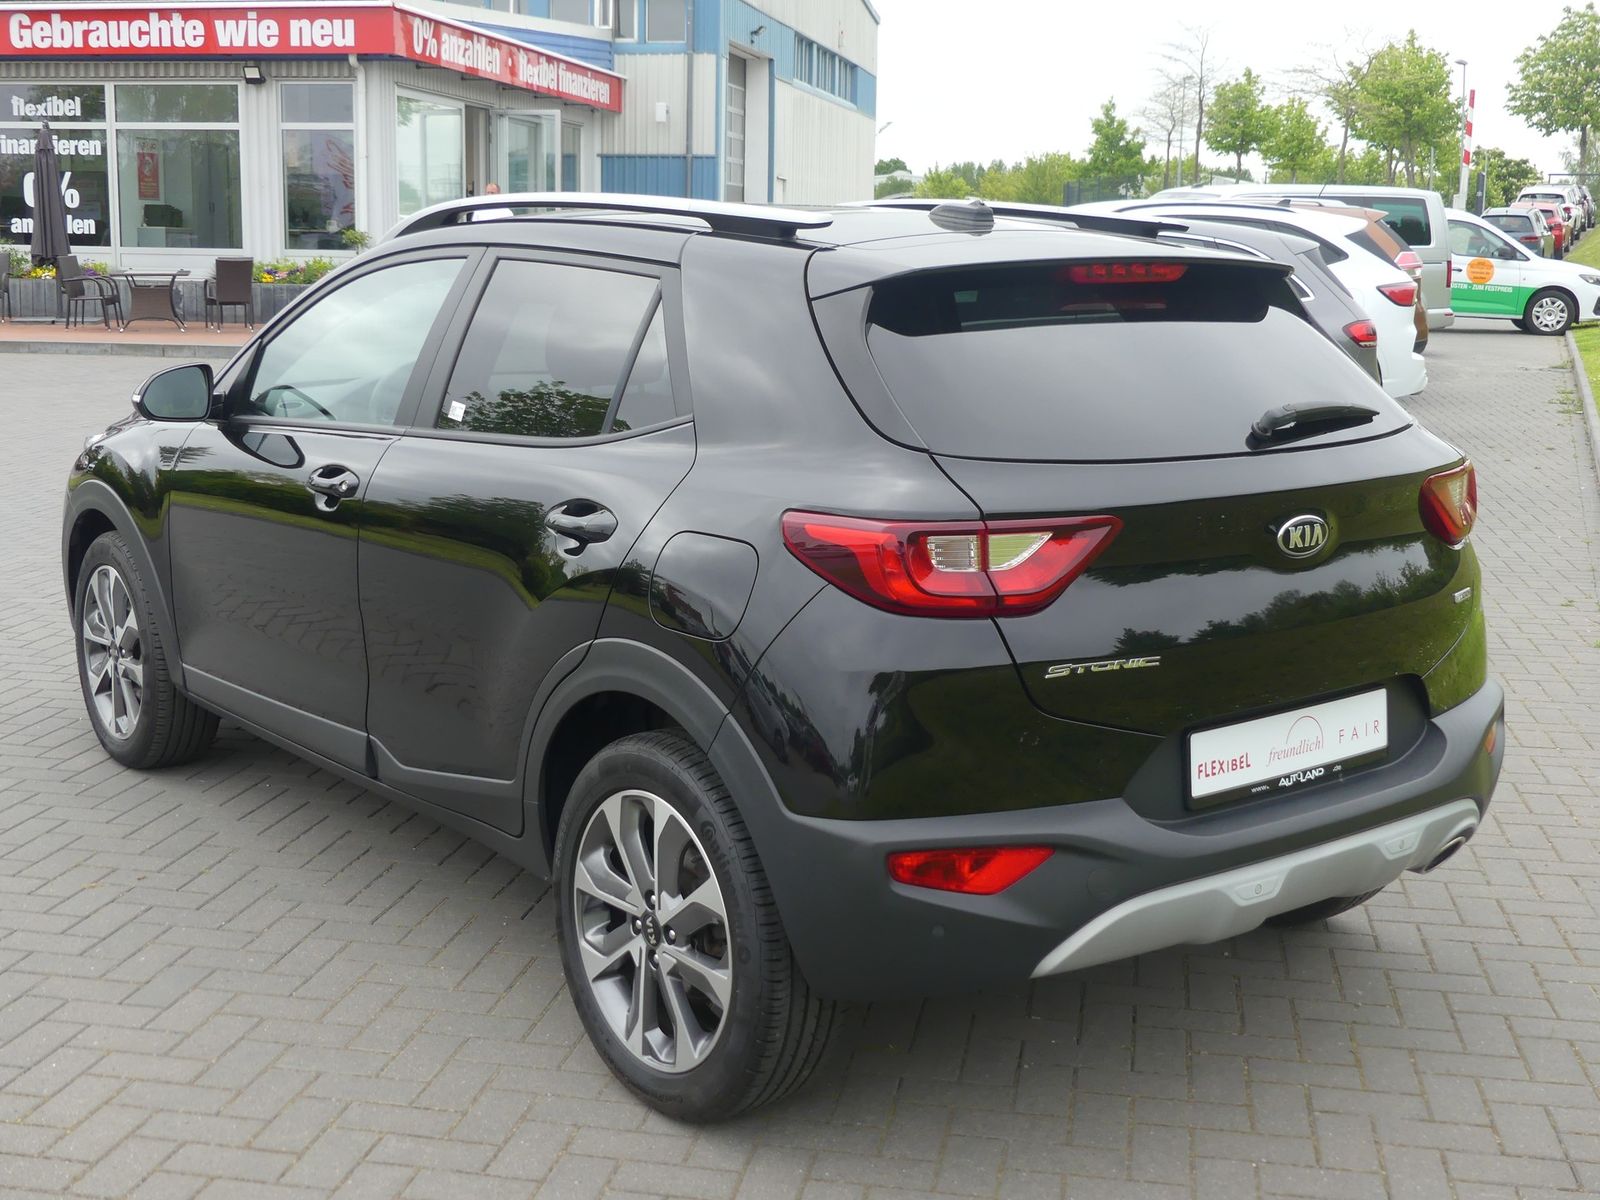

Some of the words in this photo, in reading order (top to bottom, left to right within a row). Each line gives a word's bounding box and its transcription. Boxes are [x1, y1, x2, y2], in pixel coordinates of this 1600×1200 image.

[9, 12, 205, 49] Gebrauchte
[214, 12, 279, 48] wie
[289, 18, 355, 47] neu
[413, 17, 437, 58] 0%
[441, 31, 500, 75] anzahlen
[519, 49, 558, 90] flexibel
[559, 61, 610, 104] finanzieren
[11, 95, 82, 117] flexibel
[0, 135, 102, 155] inanieren
[11, 214, 96, 235] anlen
[1289, 523, 1323, 549] KIA
[1045, 656, 1161, 679] STONIC
[1266, 735, 1321, 768] freundlich
[1278, 767, 1325, 787] AUTOLAND
[646, 916, 657, 945] KIA
